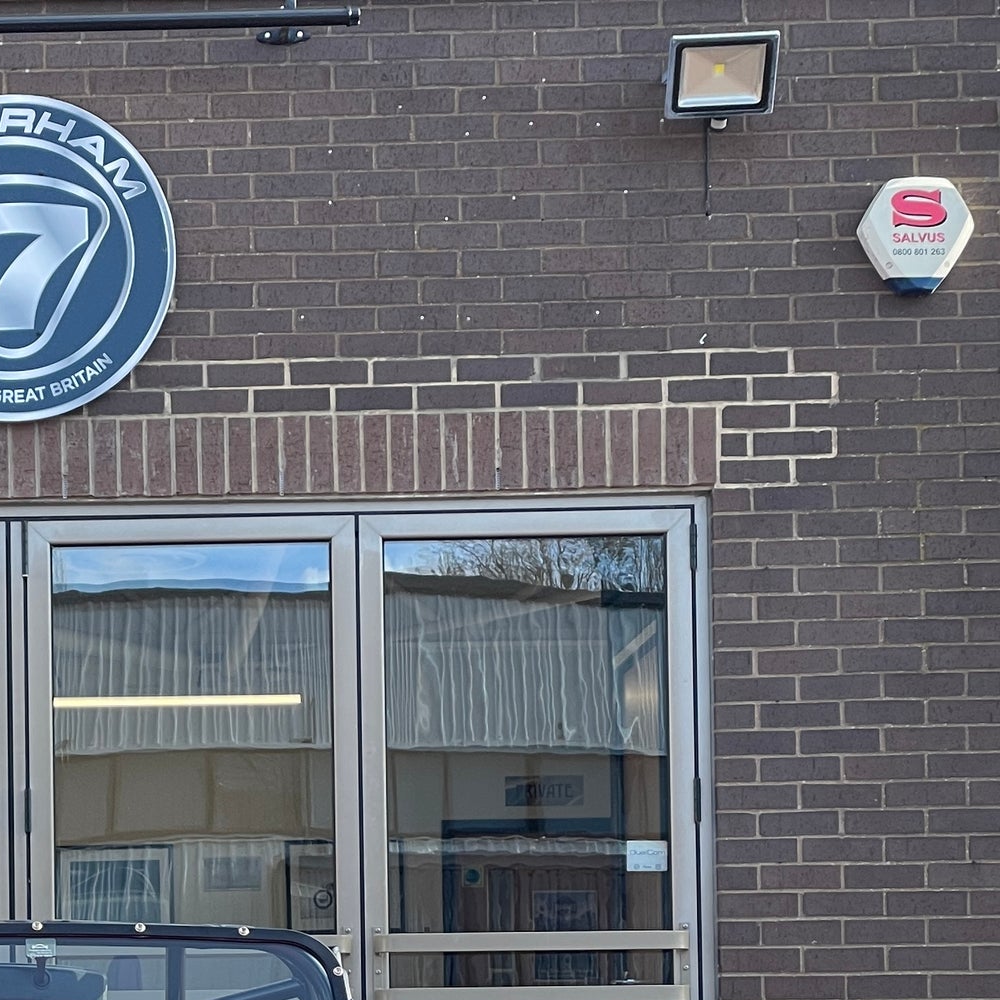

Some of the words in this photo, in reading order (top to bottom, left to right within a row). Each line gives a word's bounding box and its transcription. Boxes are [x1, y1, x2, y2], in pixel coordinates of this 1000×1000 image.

[891, 189, 947, 228] S
[892, 232, 945, 243] SALVUS
[892, 248, 912, 256] 0800
[914, 248, 928, 256] 801
[930, 248, 946, 256] 263
[49, 352, 114, 398] BRITAIN
[516, 782, 574, 799] PRIVATE
